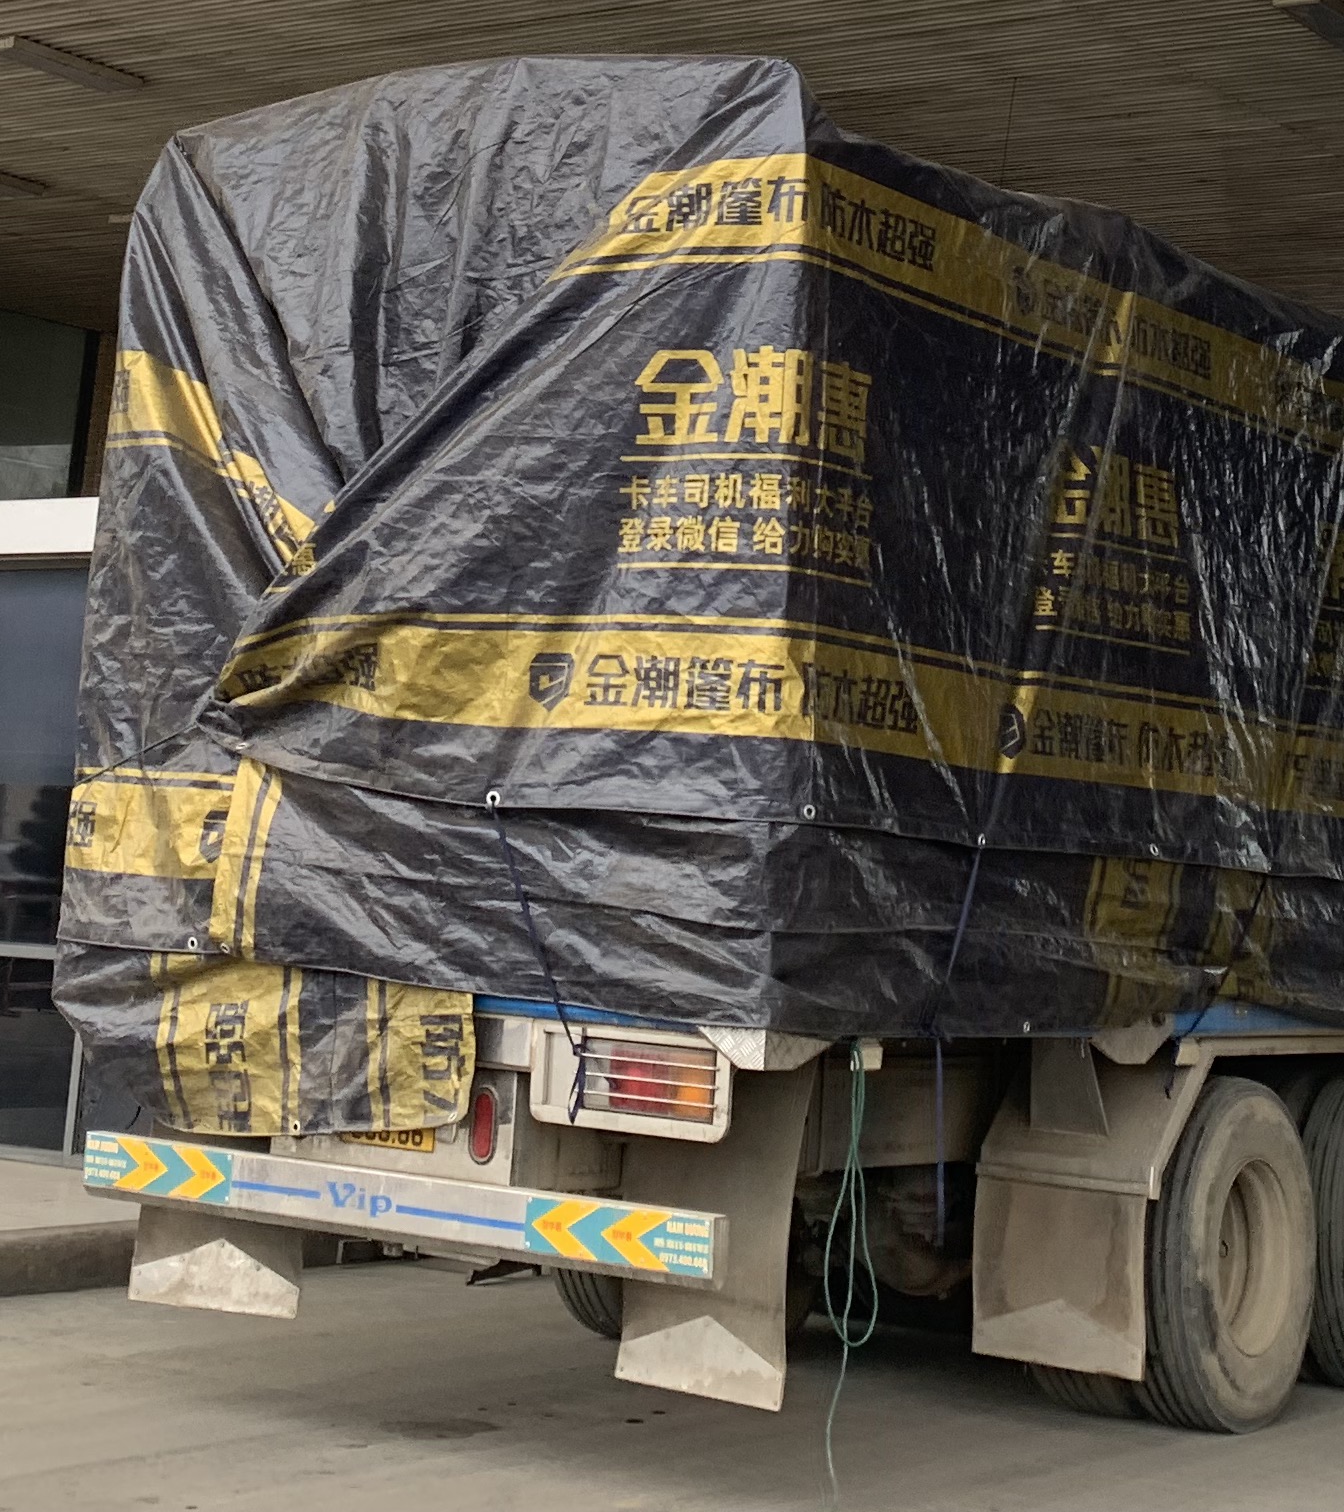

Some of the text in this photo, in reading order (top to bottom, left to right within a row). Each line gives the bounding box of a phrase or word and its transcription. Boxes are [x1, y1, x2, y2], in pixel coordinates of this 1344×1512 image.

[634, 345, 873, 464] 金潮惠
[617, 515, 740, 555] 登录微信
[584, 653, 784, 714] 金潮篷布
[326, 1181, 392, 1218] Vip
